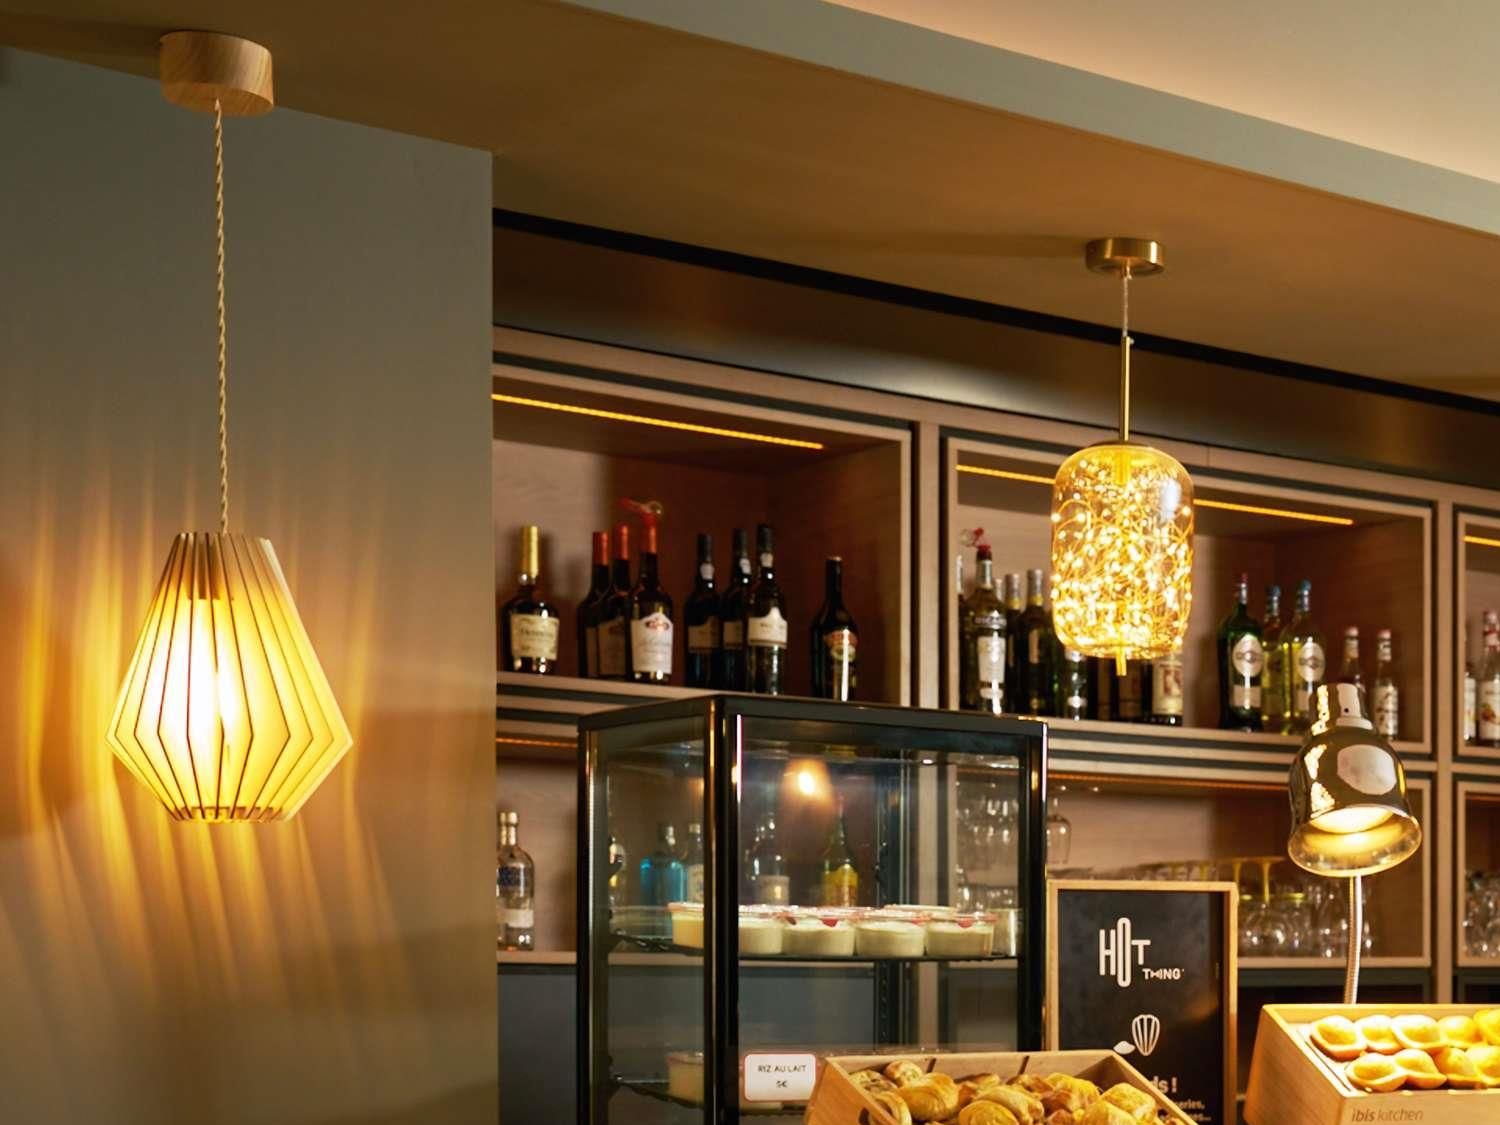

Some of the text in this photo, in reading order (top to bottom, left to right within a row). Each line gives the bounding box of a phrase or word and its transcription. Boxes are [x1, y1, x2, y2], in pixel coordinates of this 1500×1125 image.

[1099, 917, 1151, 987] HOT
[1352, 1107, 1424, 1122] ibis kitchen
